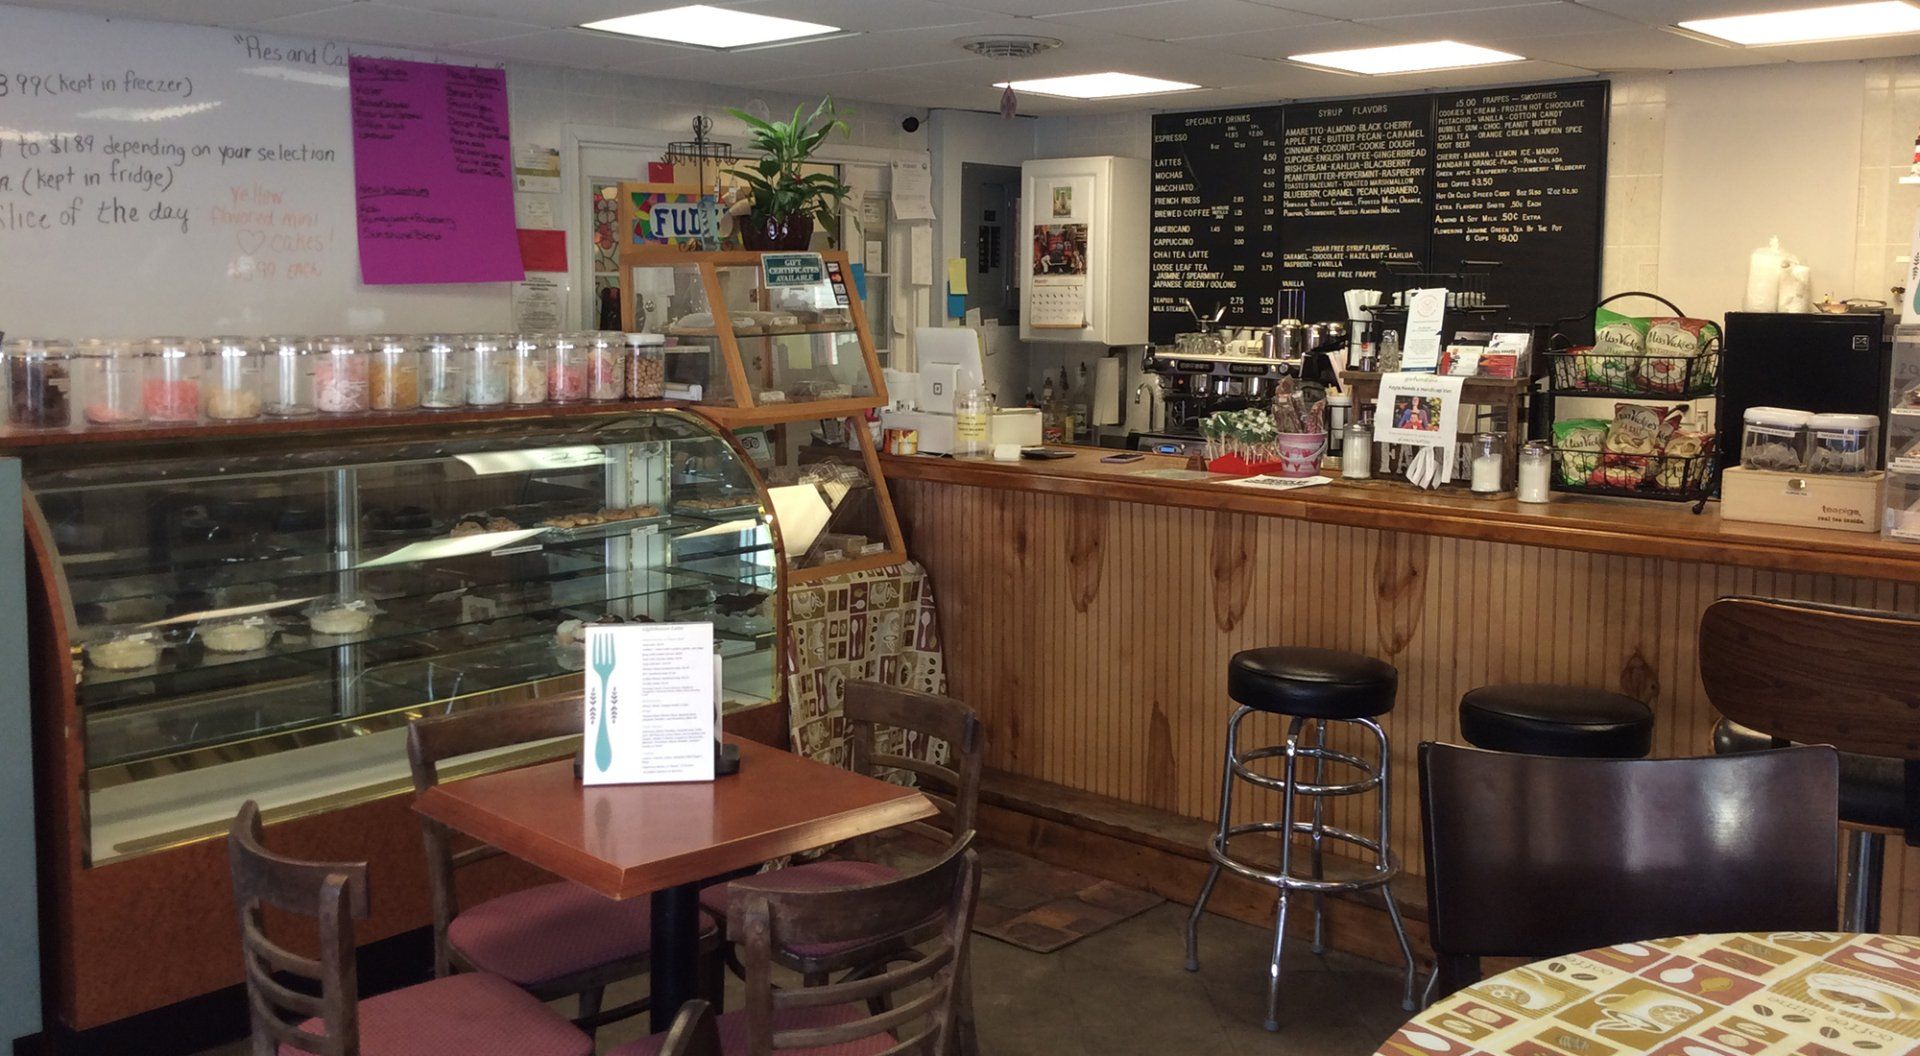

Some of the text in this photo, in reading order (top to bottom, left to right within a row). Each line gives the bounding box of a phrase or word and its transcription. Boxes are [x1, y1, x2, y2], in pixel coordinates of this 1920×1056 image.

[287, 47, 317, 64] and
[102, 79, 116, 91] in
[1483, 92, 1558, 104] FRAPPES SMOOTHIES
[1318, 105, 1388, 118] SYRUP FLAVORS
[1438, 100, 1585, 117] COOKIES CREAM FROZEN HOT CHOCOLATE
[1226, 114, 1251, 124] DRINKS
[1438, 111, 1563, 125] PISTACHIO VANILLA COTTON CANDY
[1384, 121, 1413, 130] CHERRY
[1438, 119, 1557, 134] BUBBLE GUM CHOC PEANUT BUTTER
[1155, 133, 1188, 143] ESPRESSO
[1284, 130, 1425, 146] APPLE PIE BUTTER PECAN CARAMEL
[1437, 126, 1583, 142] CHAI TEA ORANGE CREAM PUMPKIN SPICE
[1389, 140, 1415, 149] DOUGH
[1436, 142, 1452, 150] ROOT
[19, 135, 40, 159] to
[103, 136, 186, 166] depending
[192, 145, 211, 157] on
[218, 145, 251, 165] your
[258, 144, 335, 162] selection
[1436, 147, 1559, 161] CHERRY BANANA LEMON ICE MANGO
[1155, 158, 1182, 167] LATTES
[1436, 160, 1470, 169] MANDARIN
[1284, 164, 1301, 173] IRISH
[84, 172, 100, 187] in
[1155, 171, 1183, 180] MOCHAS
[1471, 178, 1493, 186] $3.50
[1155, 184, 1194, 192] MACCHIATO
[1154, 196, 1201, 205] FRENCH PRESS
[60, 196, 83, 226] of
[98, 198, 140, 224] the
[149, 203, 189, 233] day
[1154, 209, 1182, 218] BREWED
[1183, 208, 1211, 217] COFFEE
[1482, 214, 1497, 222] MILK
[1522, 213, 1541, 221] EXTRA
[1154, 225, 1191, 233] AMERICANO
[1551, 224, 1562, 232] POT
[1153, 238, 1194, 246] CAPPUCCINO
[1498, 234, 1518, 242] $9.00
[1153, 250, 1208, 259] CHAI TEA LATTE
[1210, 280, 1237, 288] OOLONG
[1260, 297, 1274, 305] 3.50
